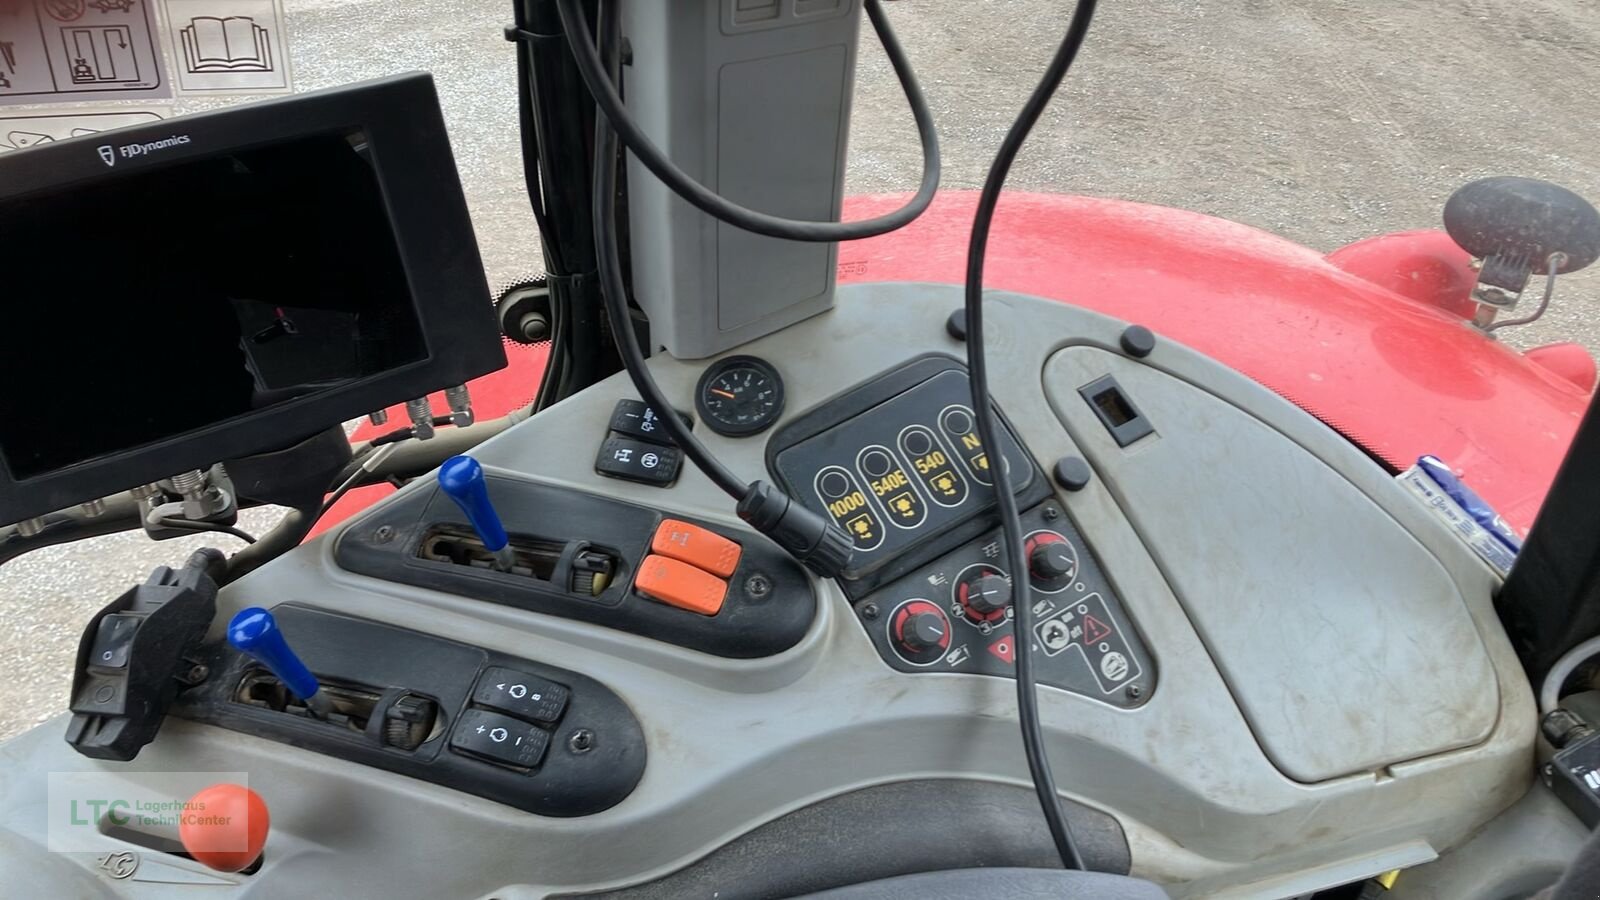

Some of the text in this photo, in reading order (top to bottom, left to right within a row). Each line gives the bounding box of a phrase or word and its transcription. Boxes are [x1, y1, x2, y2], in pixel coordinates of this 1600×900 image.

[119, 135, 191, 158] FJDynamics
[961, 433, 981, 450] N
[914, 451, 946, 475] 540
[871, 470, 908, 497] 540E
[829, 491, 866, 519] 1000
[952, 605, 964, 616] 2
[980, 622, 991, 633] 3
